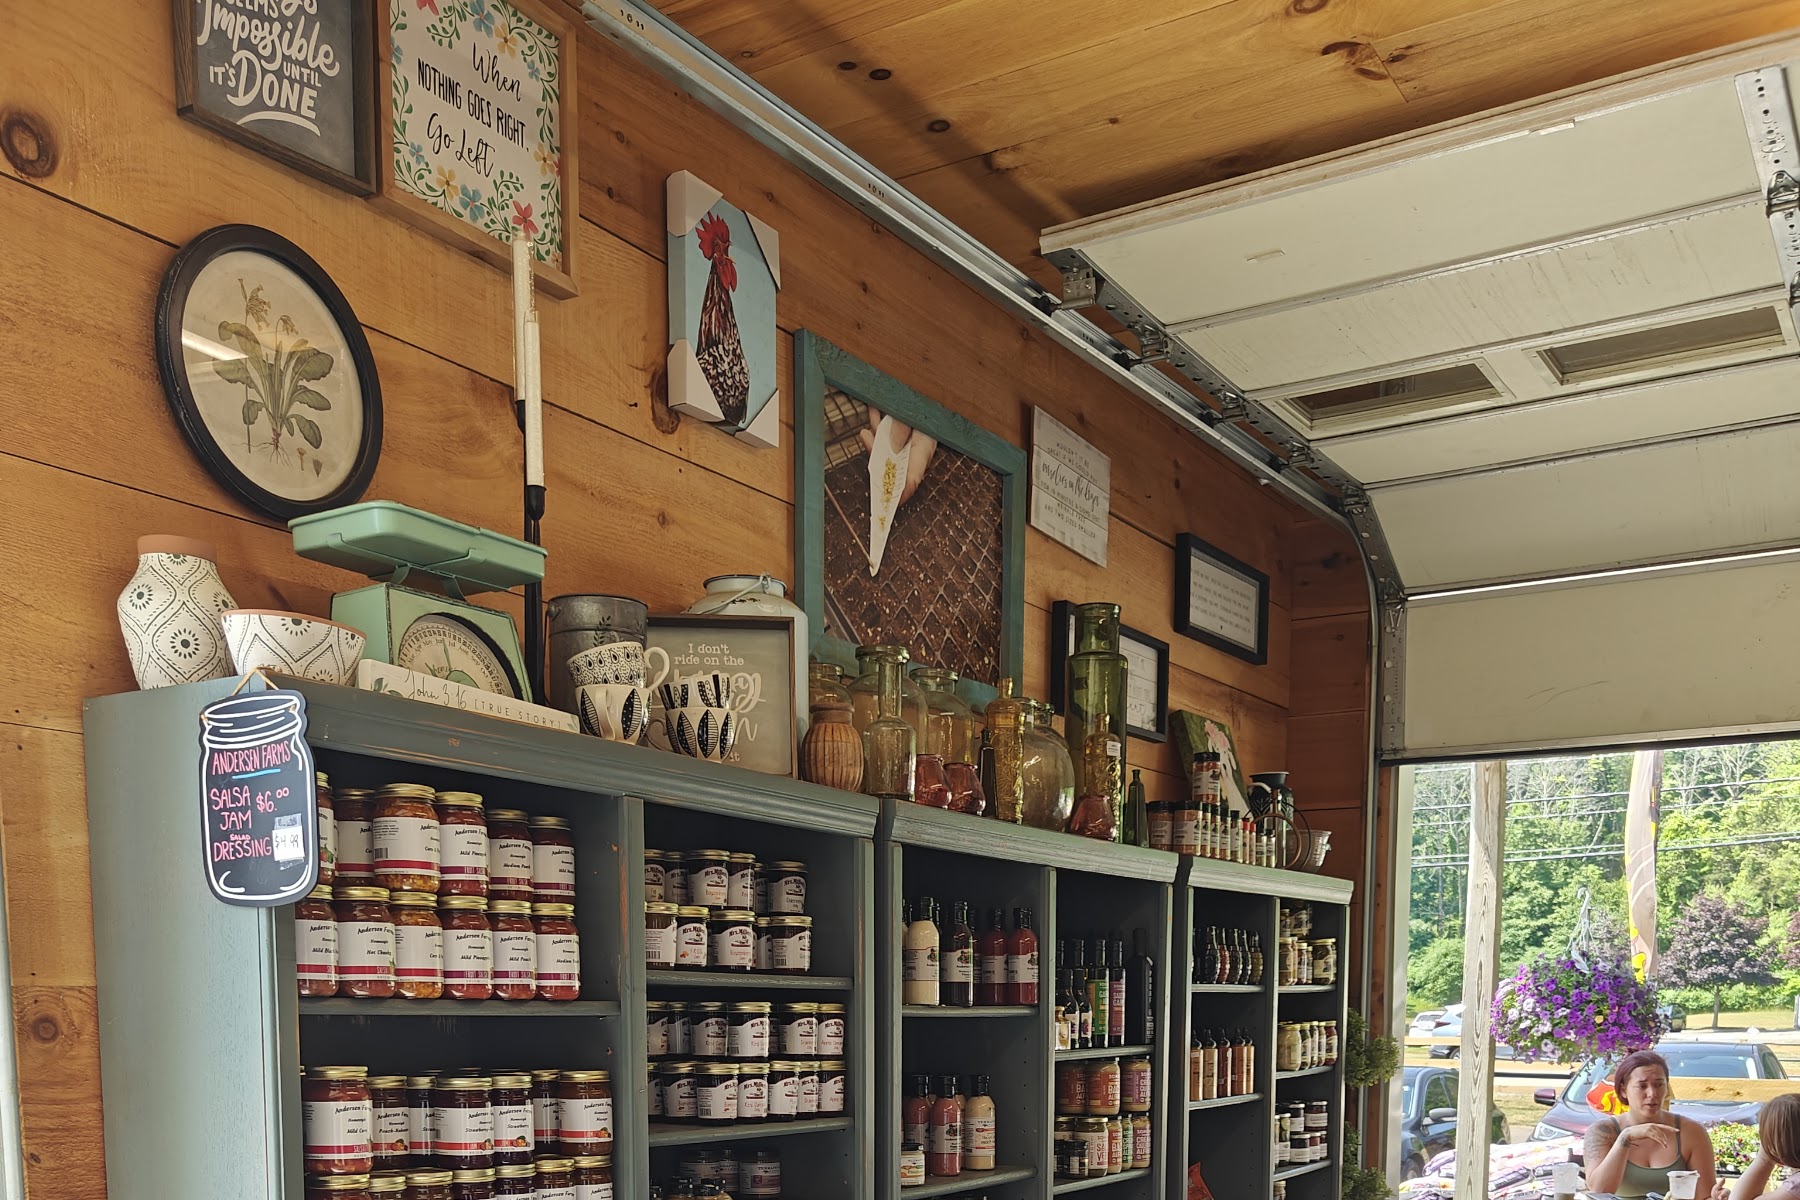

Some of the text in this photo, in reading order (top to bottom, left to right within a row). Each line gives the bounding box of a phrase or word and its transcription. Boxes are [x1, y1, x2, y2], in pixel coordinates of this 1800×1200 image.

[283, 61, 322, 87] UNTIL
[473, 42, 521, 102] When
[209, 49, 318, 119] IT'S DONE
[418, 58, 461, 109] NOTHING
[468, 89, 491, 128] GOES
[427, 113, 495, 177] Go Left
[688, 643, 730, 655] I don't
[674, 655, 745, 666] ride on the
[404, 666, 439, 700] John
[443, 683, 467, 710] 3:16
[212, 740, 291, 776] ANDERSEN FARMS
[730, 751, 740, 762] it
[210, 785, 250, 811] SALSA
[219, 809, 252, 831] JAM
[420, 823, 439, 831] Anderse
[455, 829, 478, 837] Andersen
[229, 833, 251, 842] SALAD
[213, 837, 272, 862] DRESSING
[499, 842, 522, 850] Andersen
[310, 925, 332, 933] Anderse
[358, 926, 383, 935] Andersen
[335, 1105, 360, 1114] Andersen
[541, 1192, 564, 1200] Andersen
